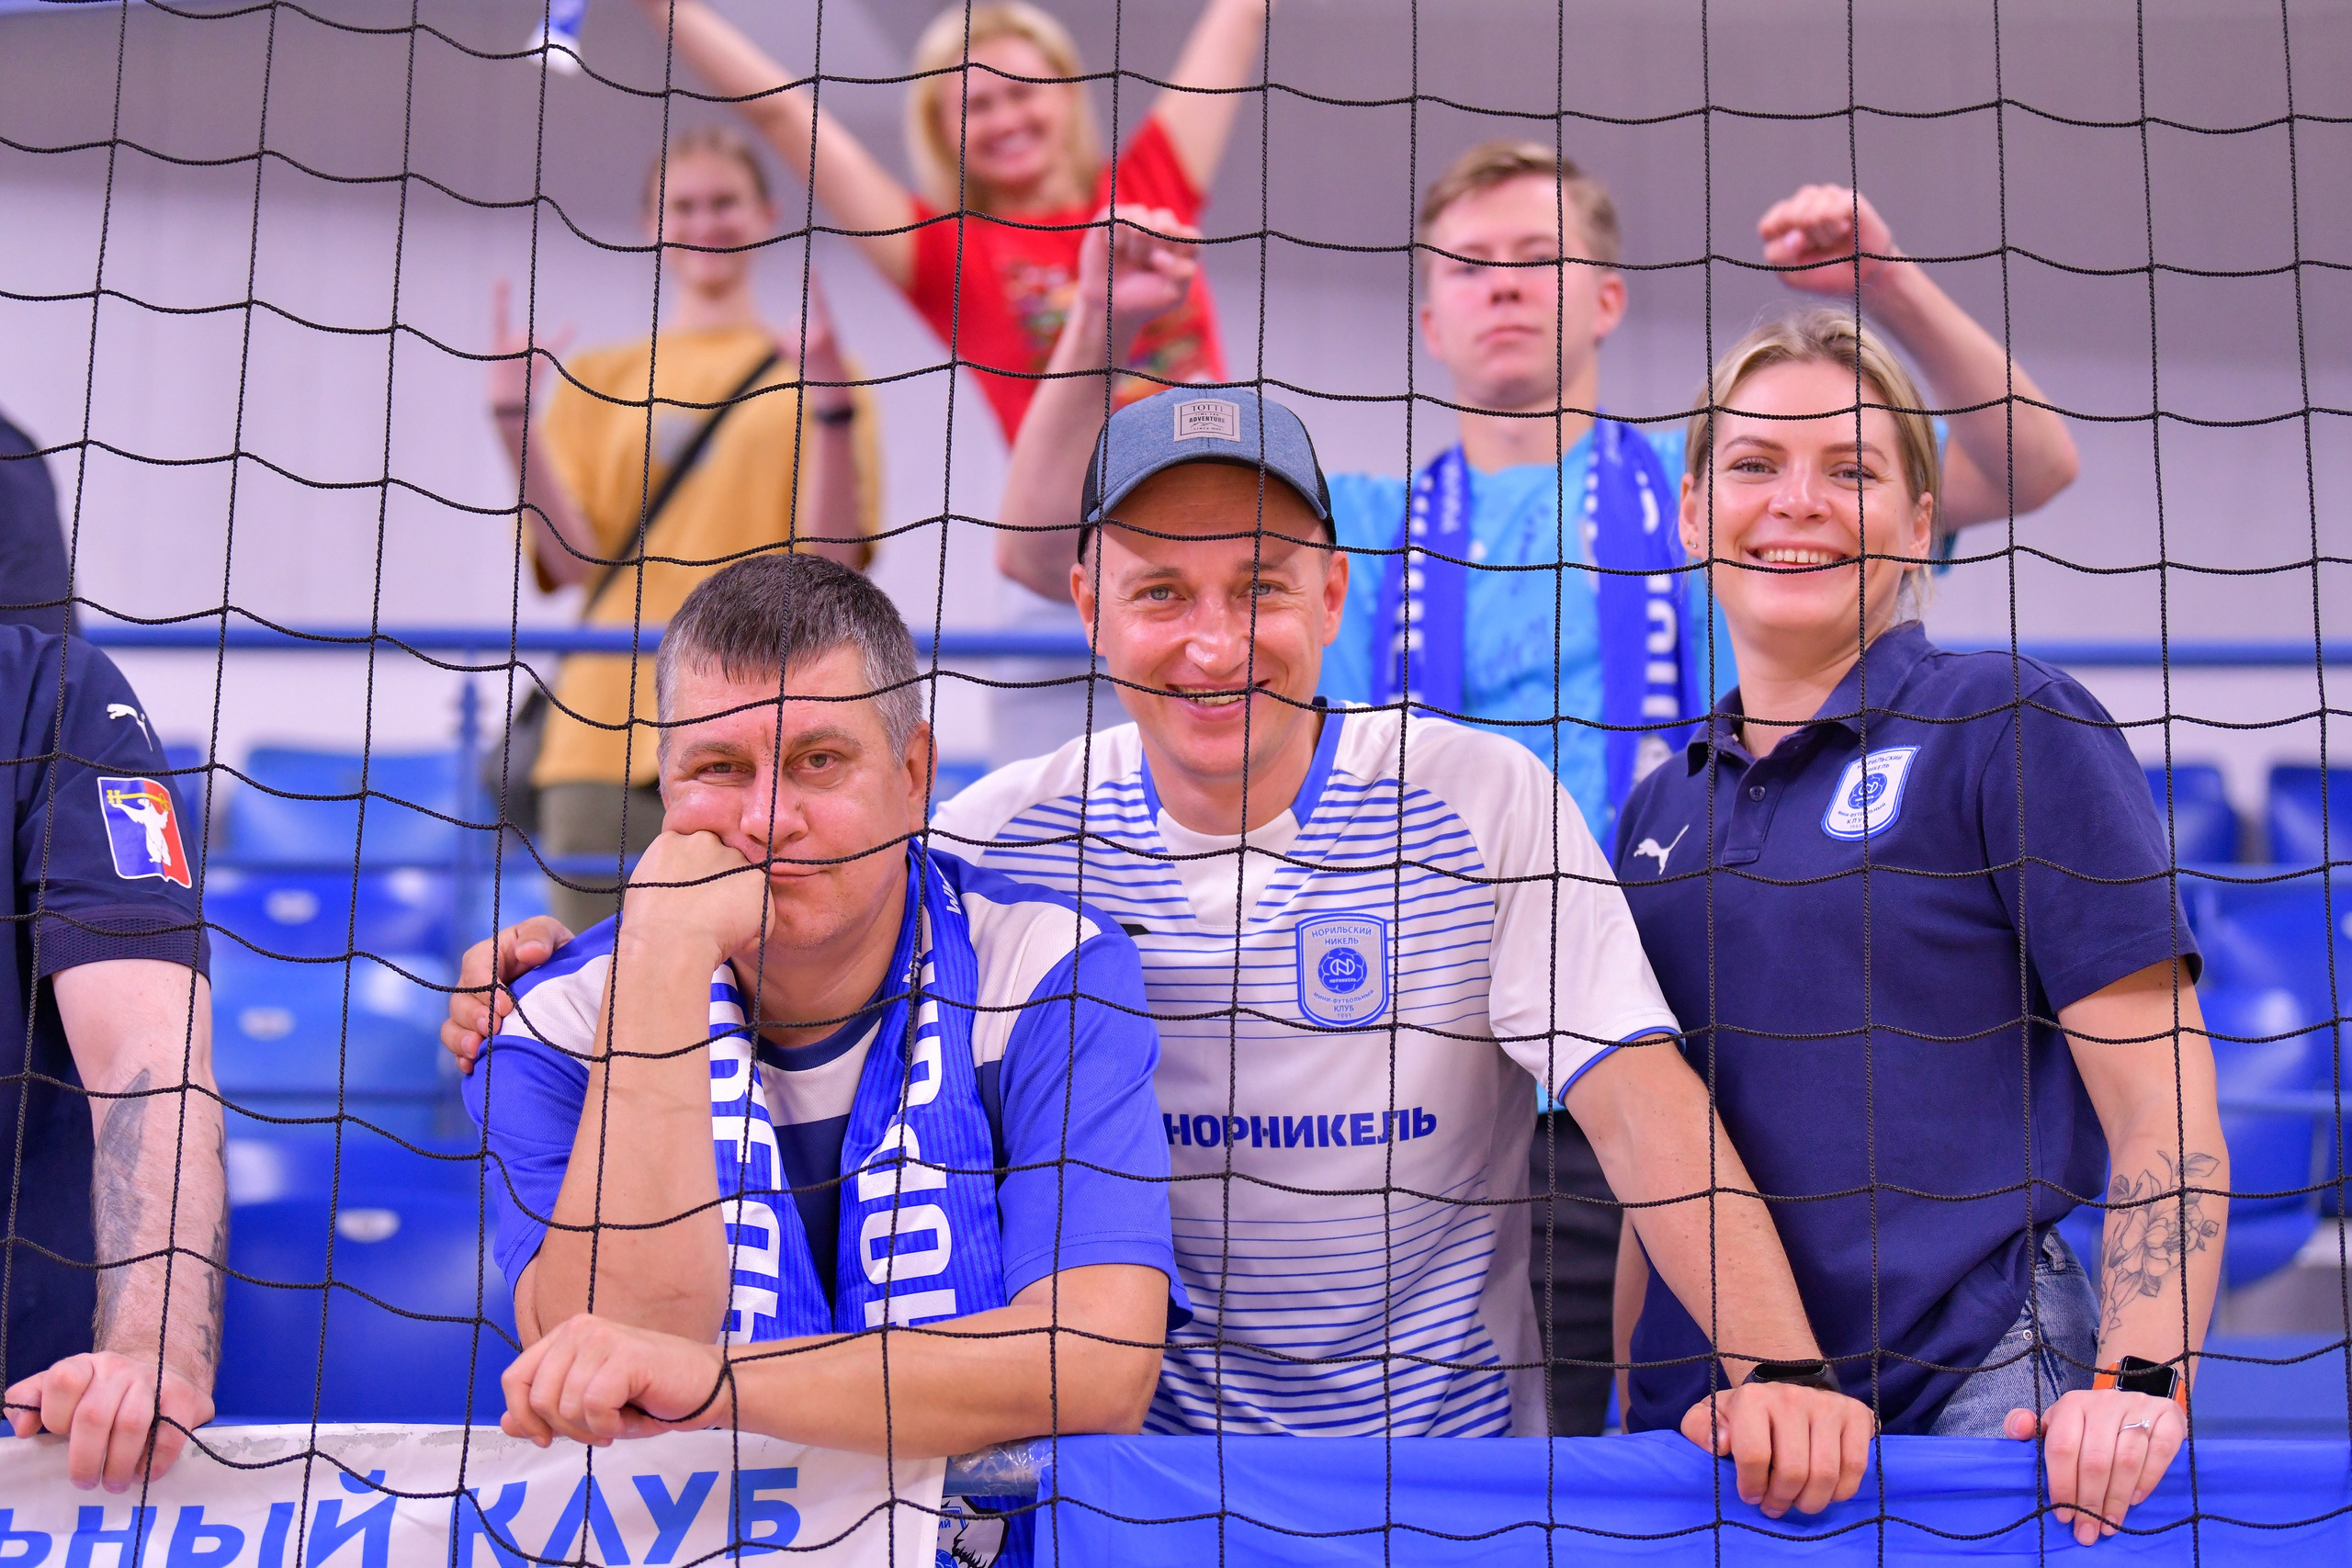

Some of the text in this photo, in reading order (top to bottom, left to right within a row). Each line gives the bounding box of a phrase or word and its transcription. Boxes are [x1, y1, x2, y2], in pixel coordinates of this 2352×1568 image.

[1191, 404, 1223, 412] TOTTI
[1189, 415, 1226, 423] ADVENTURE
[1311, 926, 1373, 938] НОРИЛЬСКИЙ
[1325, 937, 1360, 945] НИКЕЛЬ
[1313, 988, 1375, 1004] МИНИ-ФУТБОЛЬНЫЙ
[1333, 1005, 1355, 1013] КЛУБ
[1162, 1106, 1438, 1149] НОРНИКЕЛЬ
[447, 1466, 801, 1568] КЛУБ
